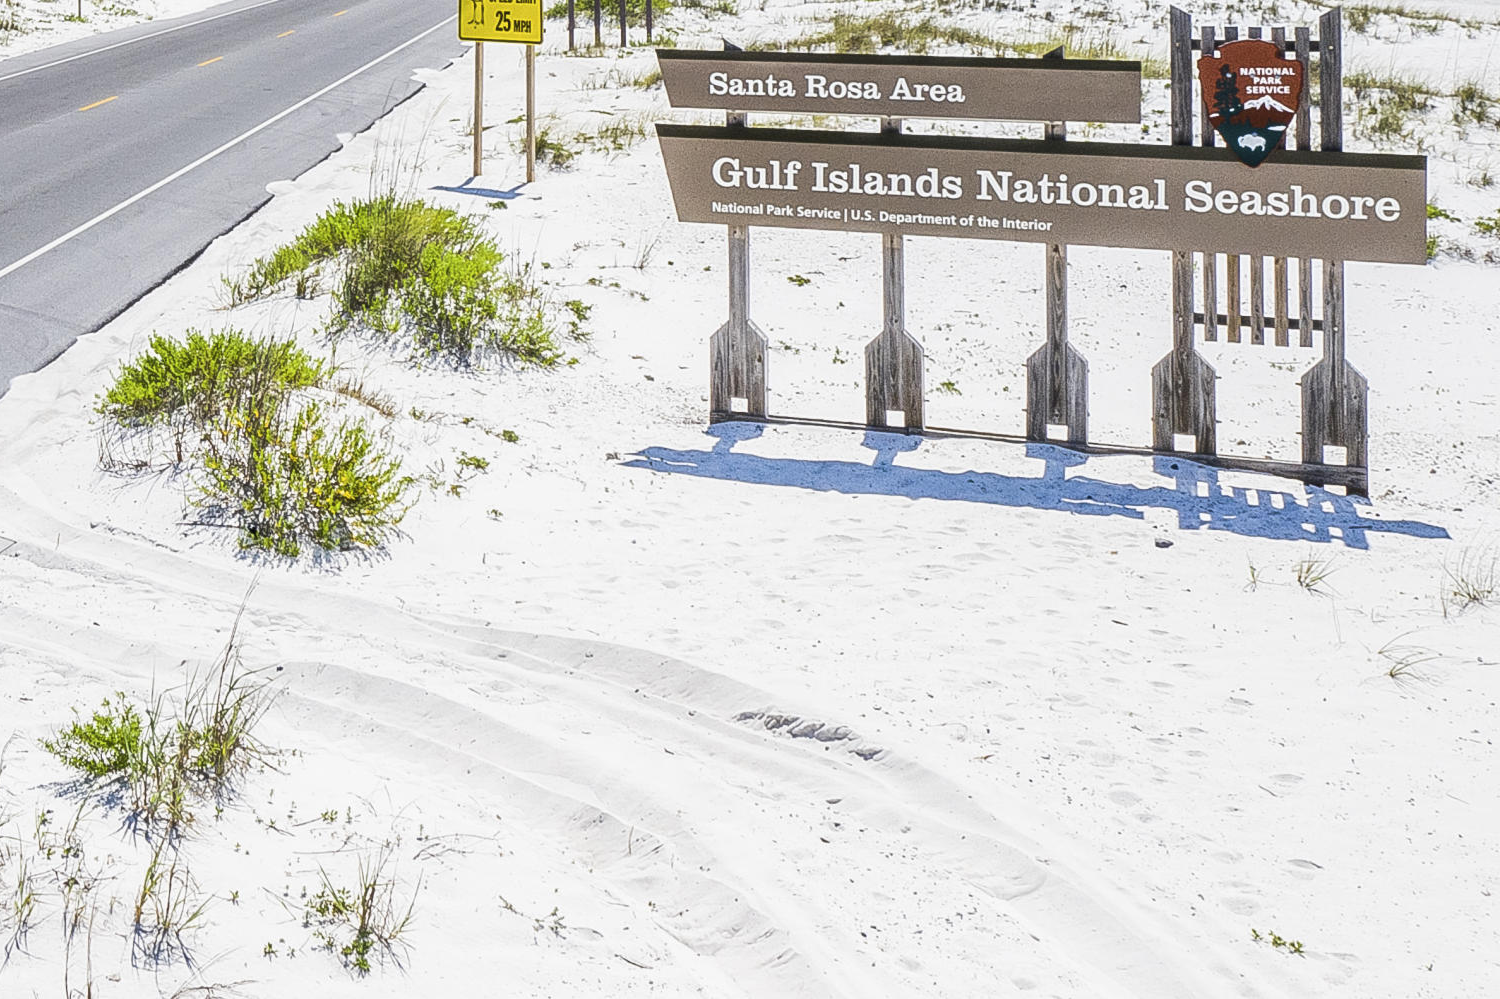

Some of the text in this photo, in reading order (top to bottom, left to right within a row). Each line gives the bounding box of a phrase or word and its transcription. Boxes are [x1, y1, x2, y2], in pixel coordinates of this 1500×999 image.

[495, 11, 531, 33] 25 MPH
[1240, 67, 1295, 76] NATIONAL
[1253, 77, 1282, 85] PARK
[709, 72, 966, 103] Santa Rosa Area
[1245, 86, 1290, 94] SERVICE
[711, 156, 1401, 222] Gulf Islands National Seashore
[712, 202, 1053, 231] National Park Service U.S. Department of the Interior
